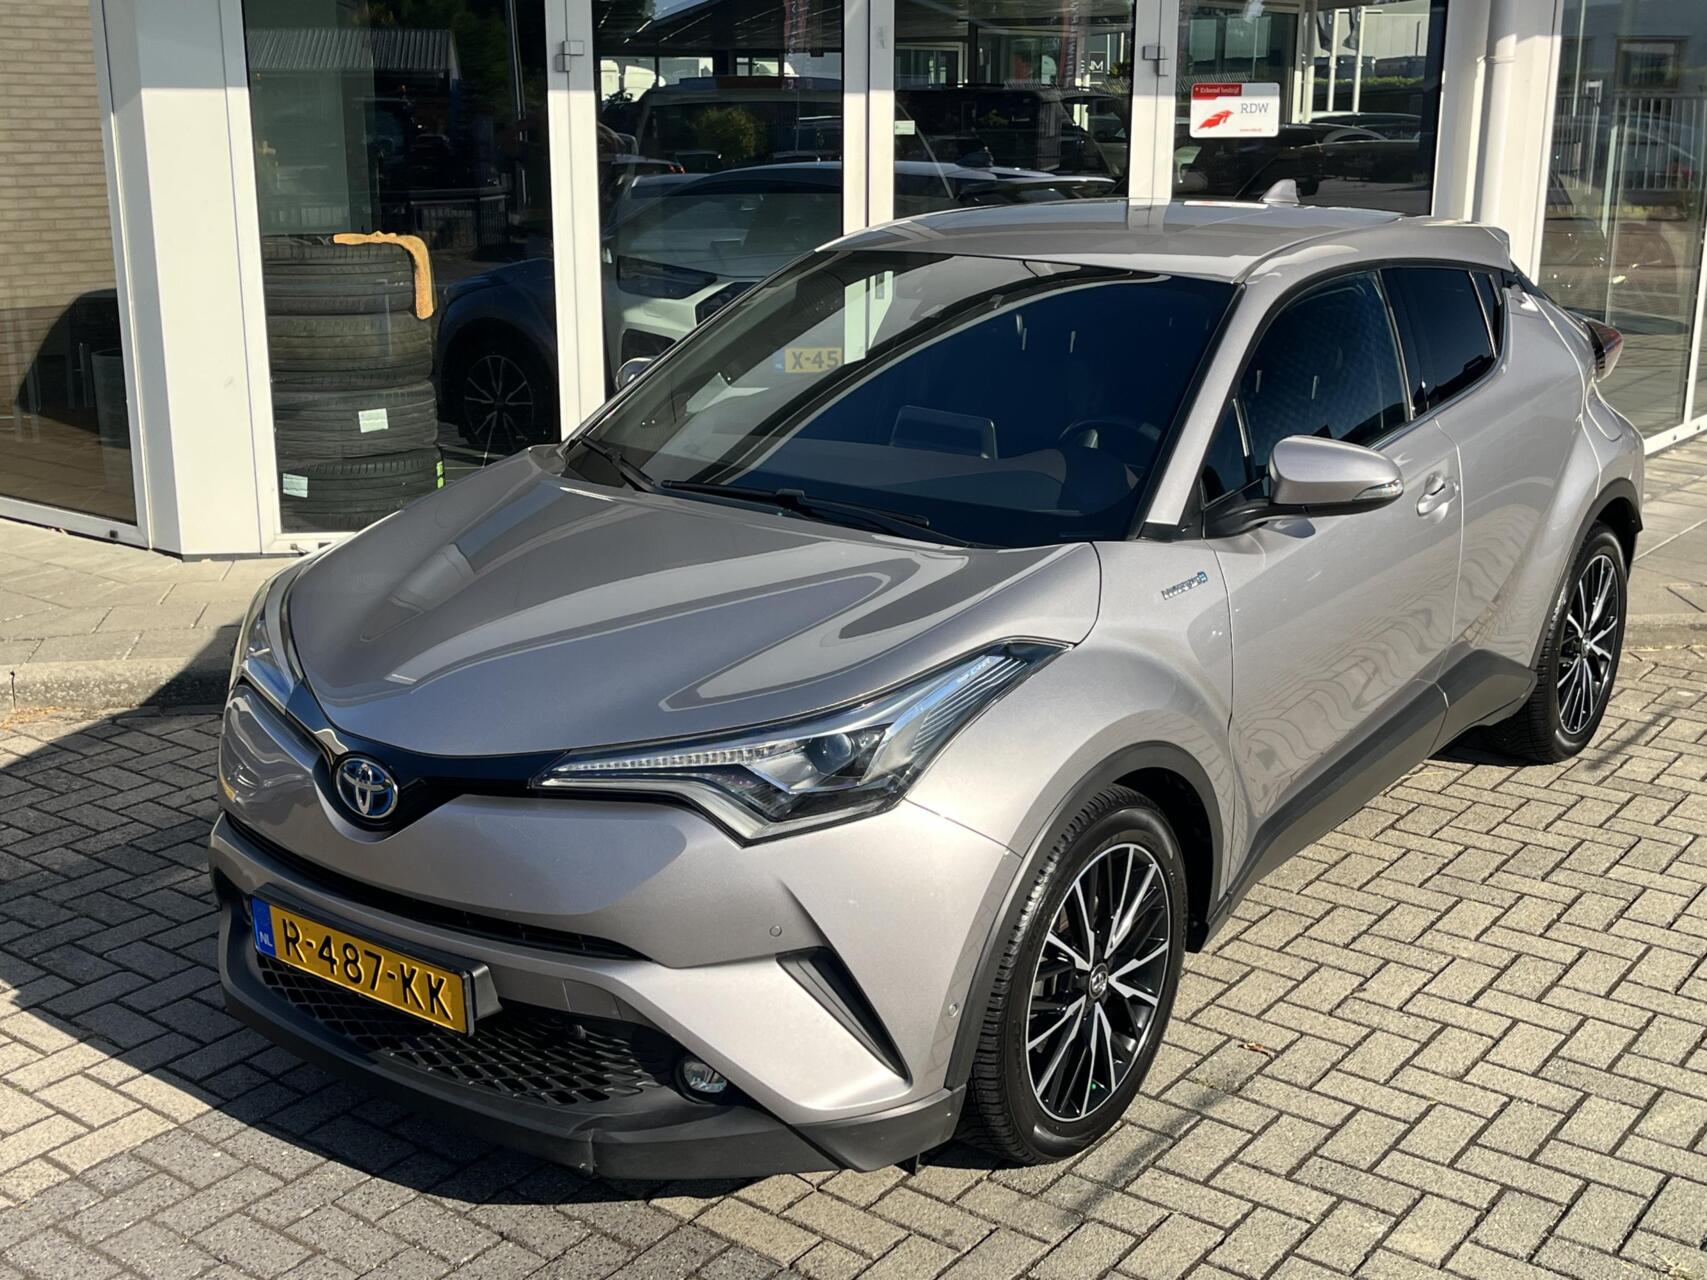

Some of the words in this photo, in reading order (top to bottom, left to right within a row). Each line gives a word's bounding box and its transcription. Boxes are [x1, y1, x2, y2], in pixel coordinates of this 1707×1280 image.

[1241, 103, 1269, 114] RDW
[259, 931, 273, 948] NL
[282, 918, 454, 1021] R-487-KK
